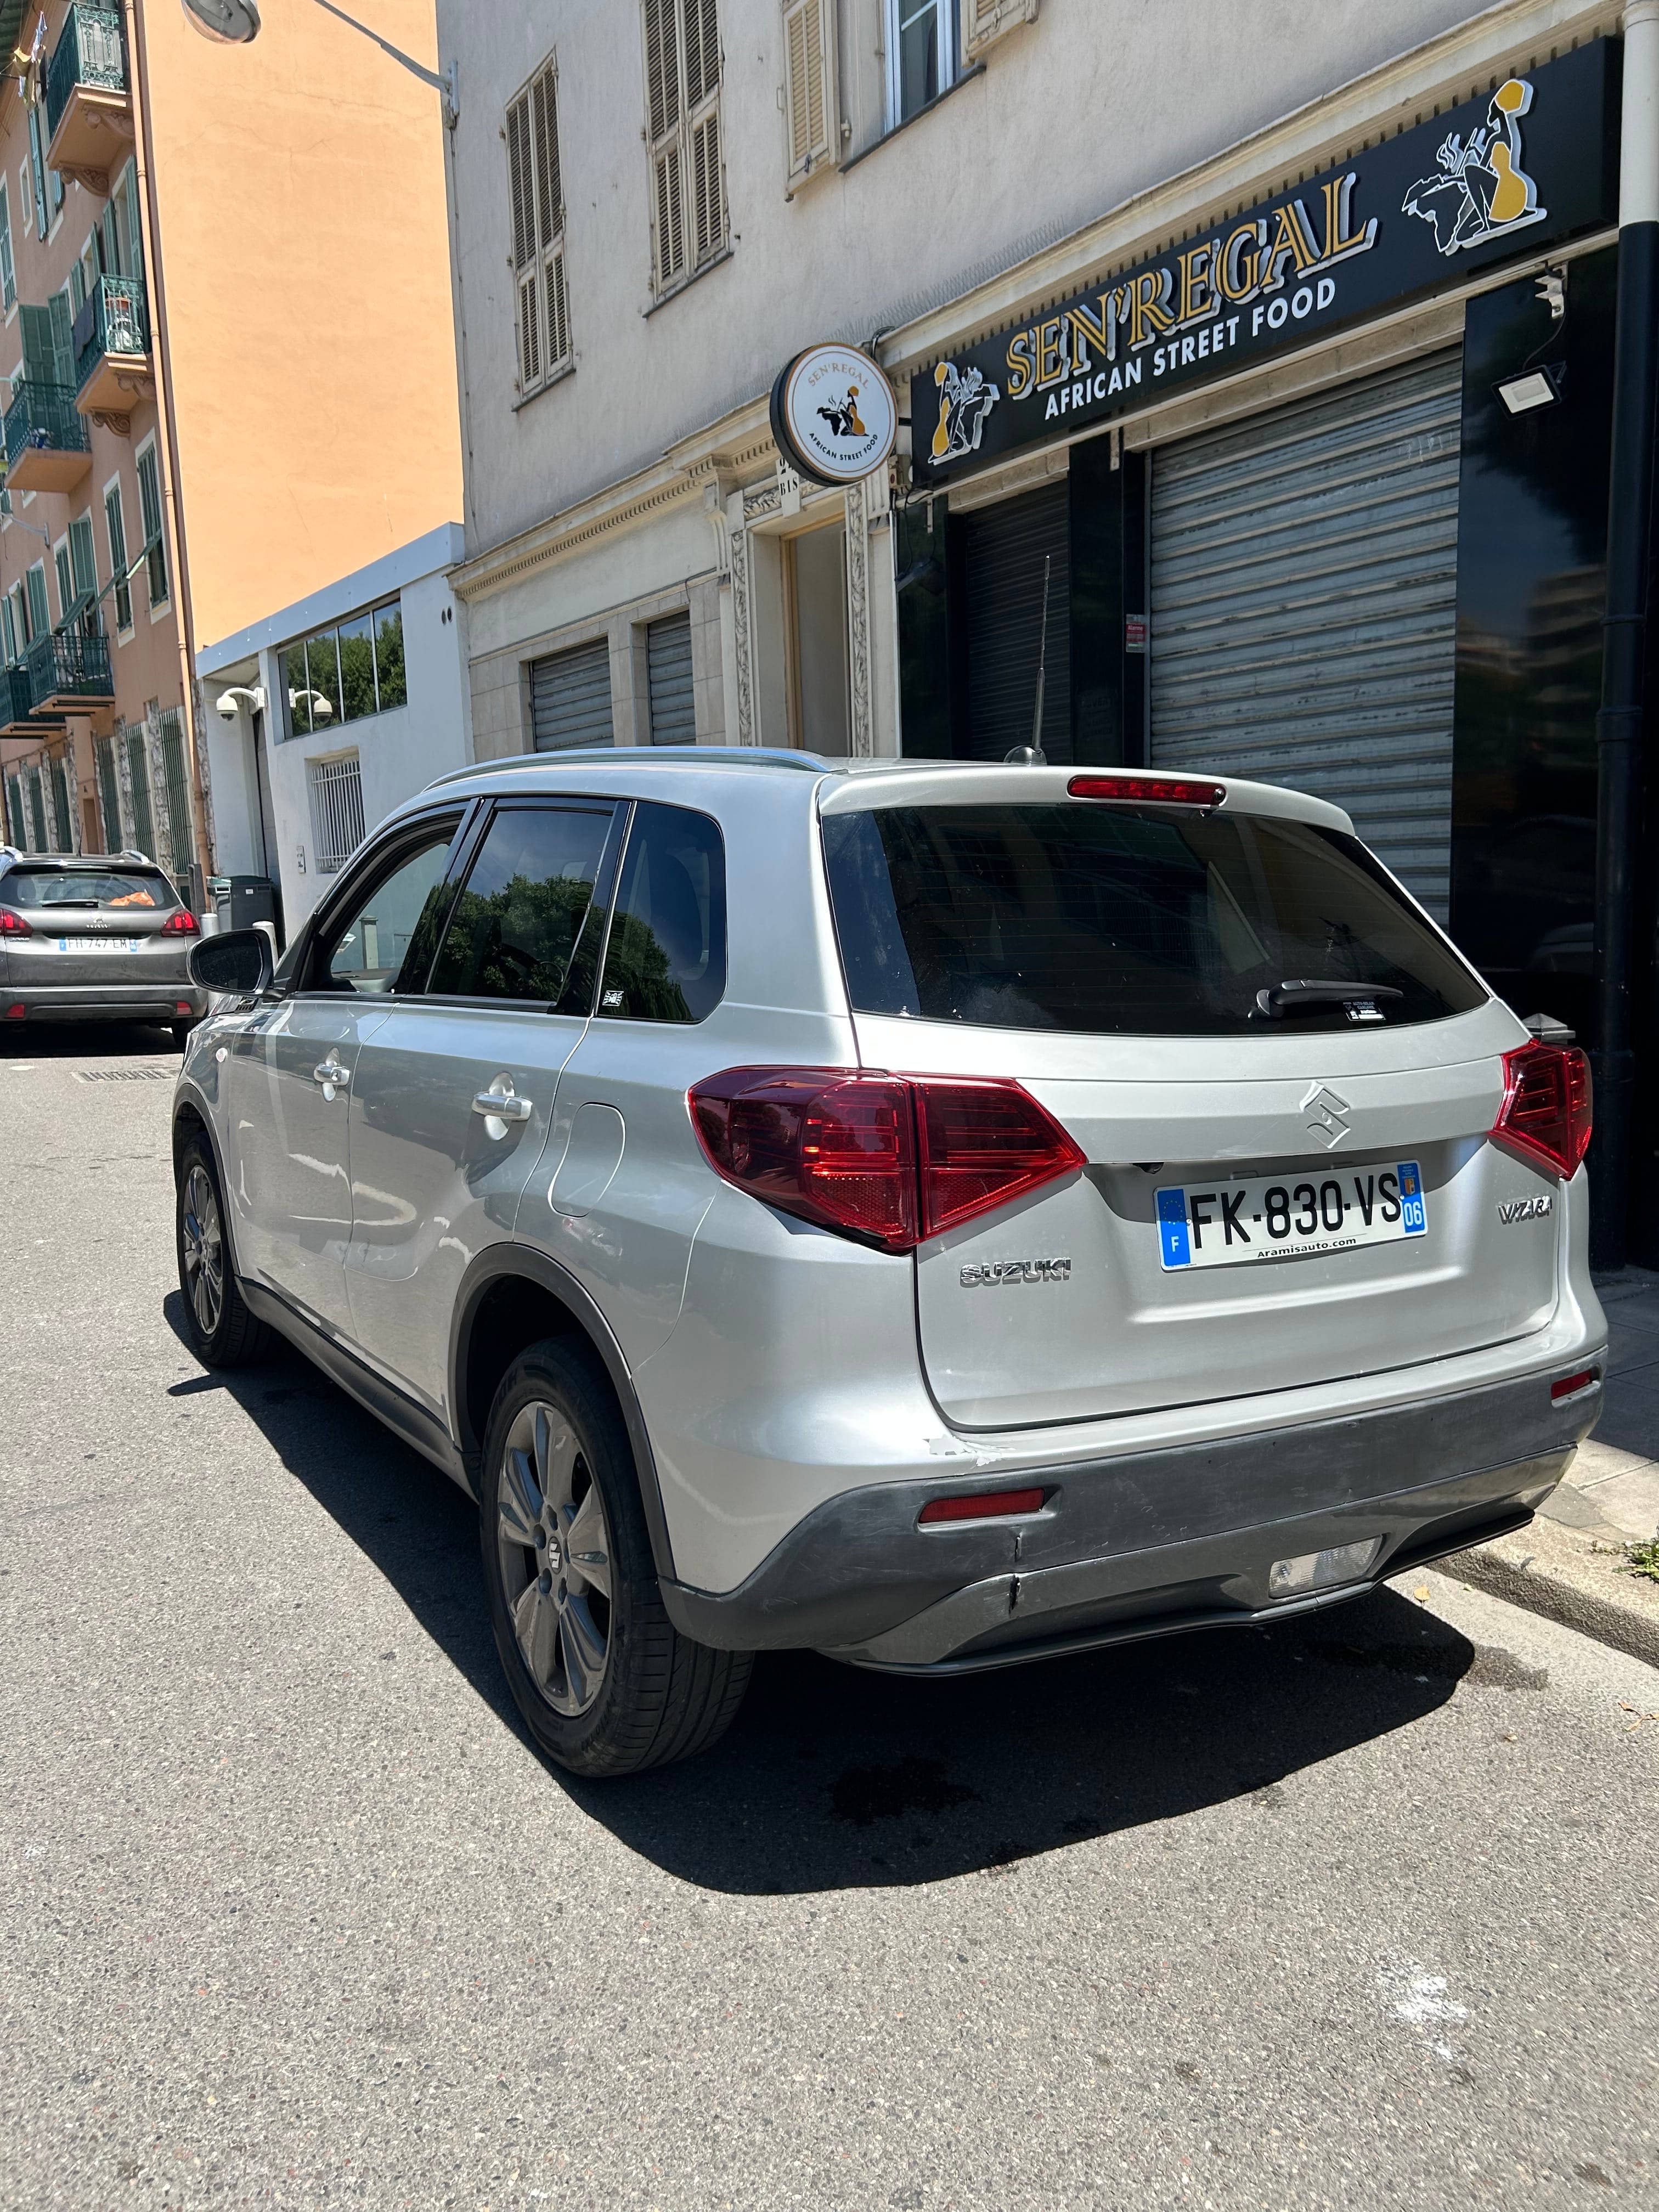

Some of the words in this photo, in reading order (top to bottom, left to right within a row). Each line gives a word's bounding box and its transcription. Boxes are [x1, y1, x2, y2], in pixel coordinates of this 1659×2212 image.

[1006, 172, 1378, 399] SEN'REGAL
[1045, 358, 1142, 421] AFRICAN
[1153, 315, 1239, 376] STREET
[1252, 278, 1336, 337] FOOD
[808, 363, 869, 389] SEN'REGAL
[809, 433, 837, 459] AFRICAN
[839, 451, 863, 461] STREET
[863, 434, 878, 454] FOOD
[780, 477, 798, 496] BIS
[1404, 1201, 1423, 1227] 06
[1171, 1235, 1180, 1252] F
[1257, 1237, 1357, 1259] Aramisauto.com
[960, 1256, 1071, 1286] SUZUKI
